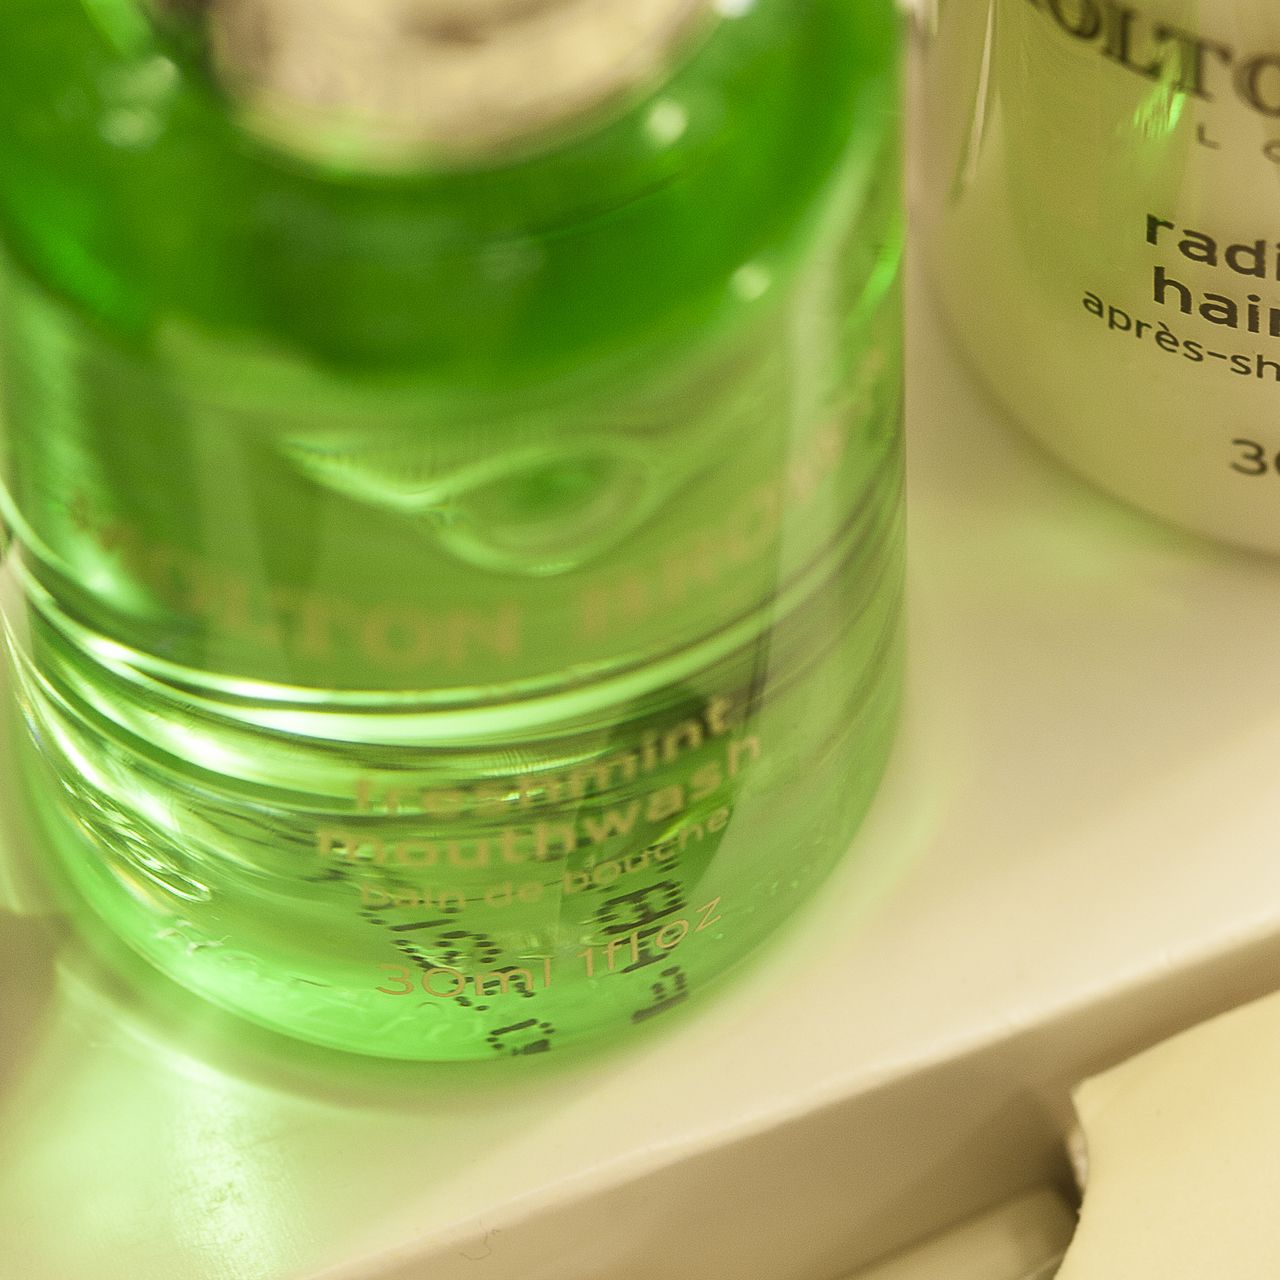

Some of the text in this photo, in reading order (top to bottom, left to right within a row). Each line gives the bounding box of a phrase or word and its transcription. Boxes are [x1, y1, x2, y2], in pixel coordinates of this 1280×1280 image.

[317, 734, 760, 868] mouthwash
[485, 879, 545, 908] de
[563, 805, 730, 895] bouche
[376, 958, 552, 998] 30ml
[656, 896, 722, 949] oz
